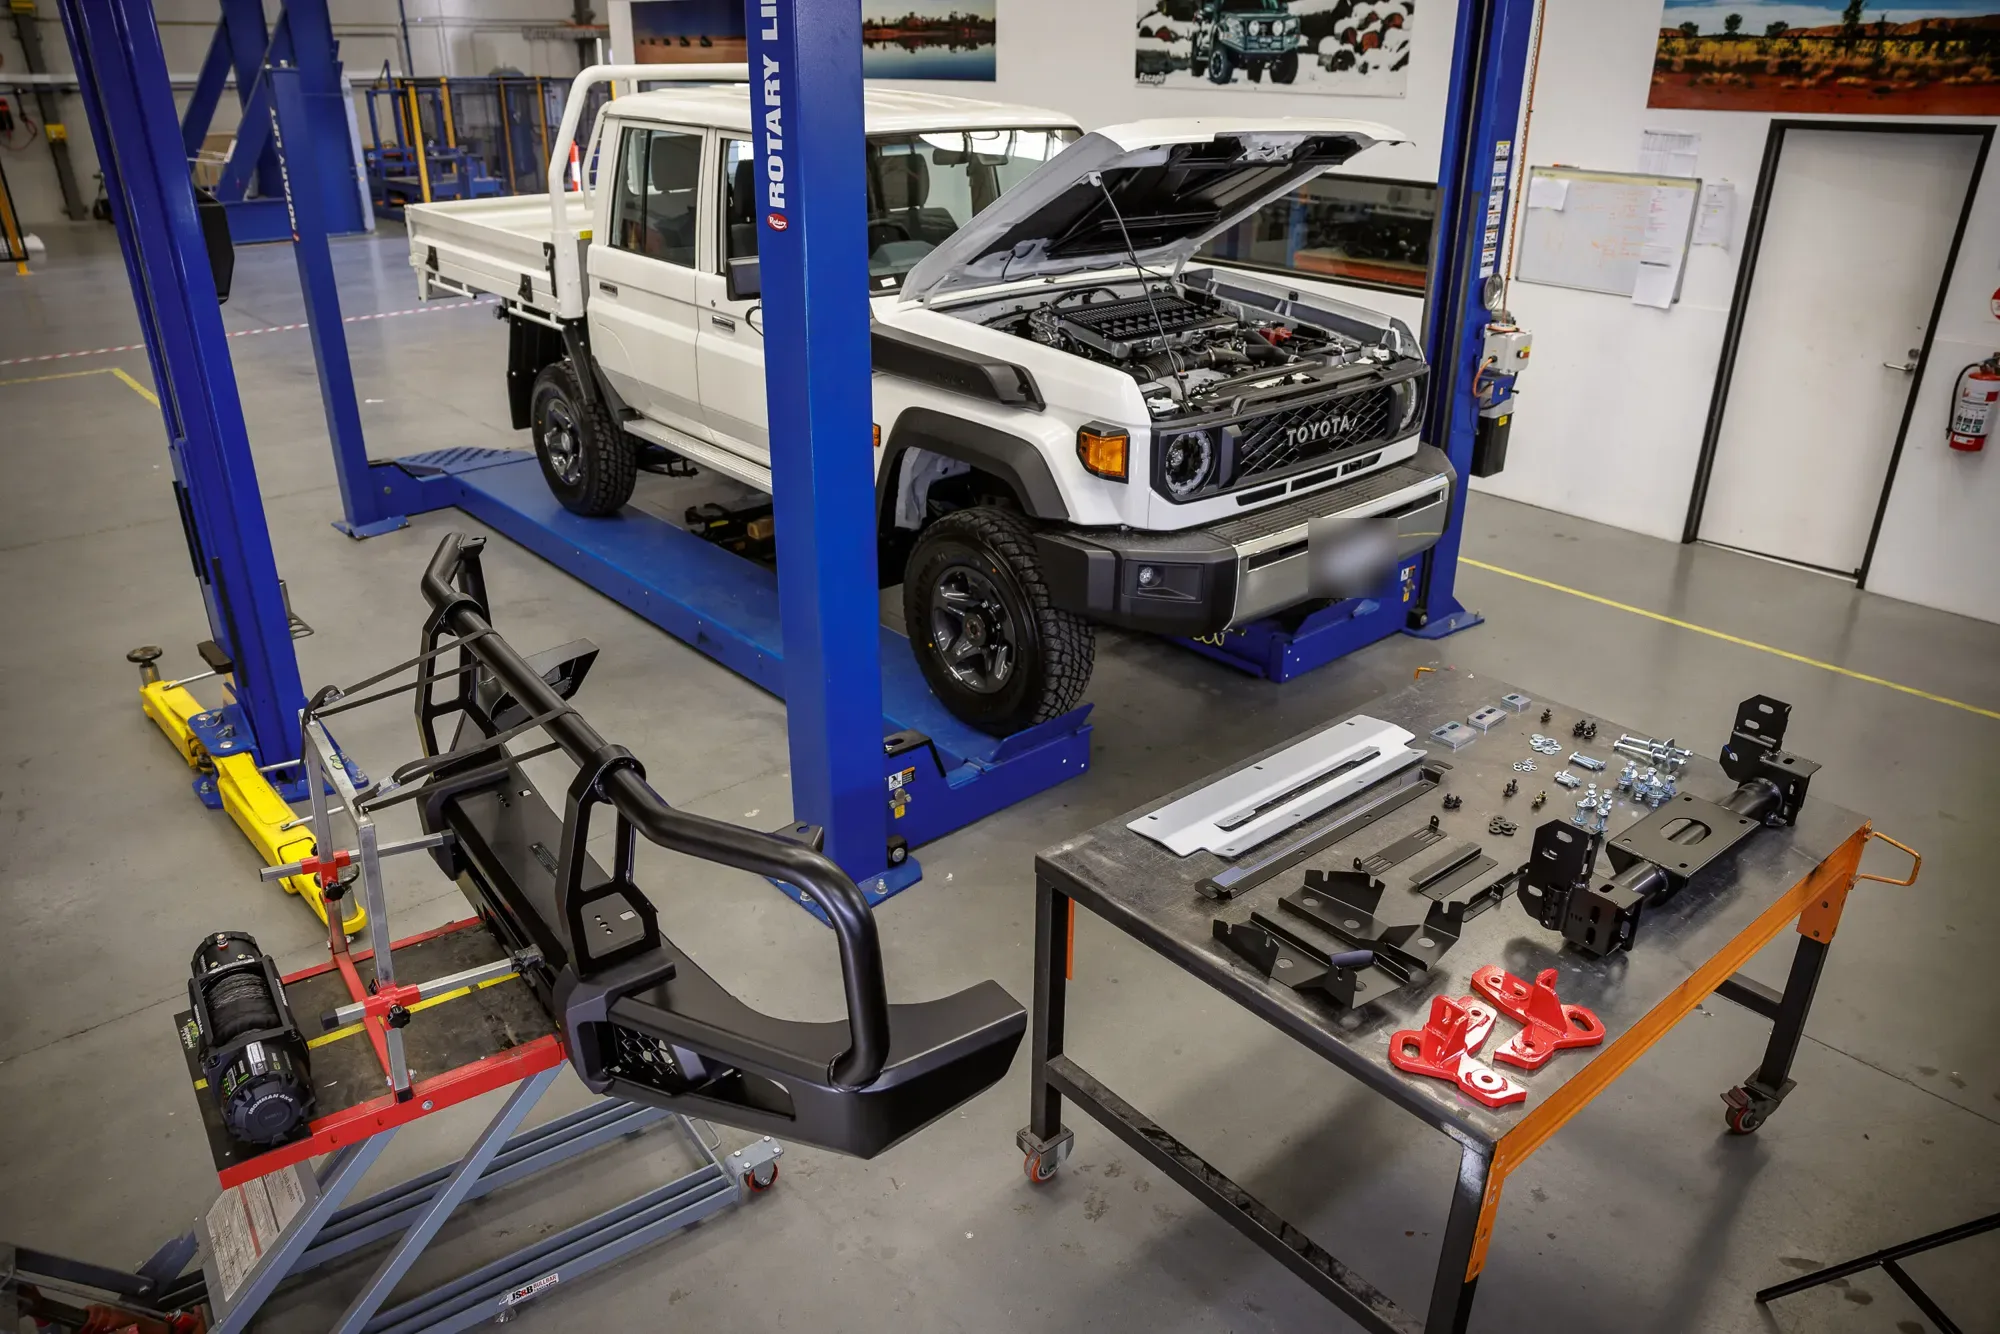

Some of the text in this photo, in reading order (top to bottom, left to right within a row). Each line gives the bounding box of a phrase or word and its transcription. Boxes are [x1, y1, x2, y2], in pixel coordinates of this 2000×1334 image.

[760, 0, 785, 209] ROTARY LI
[1286, 415, 1350, 446] TOYOTA
[248, 1093, 279, 1115] IRONMAN
